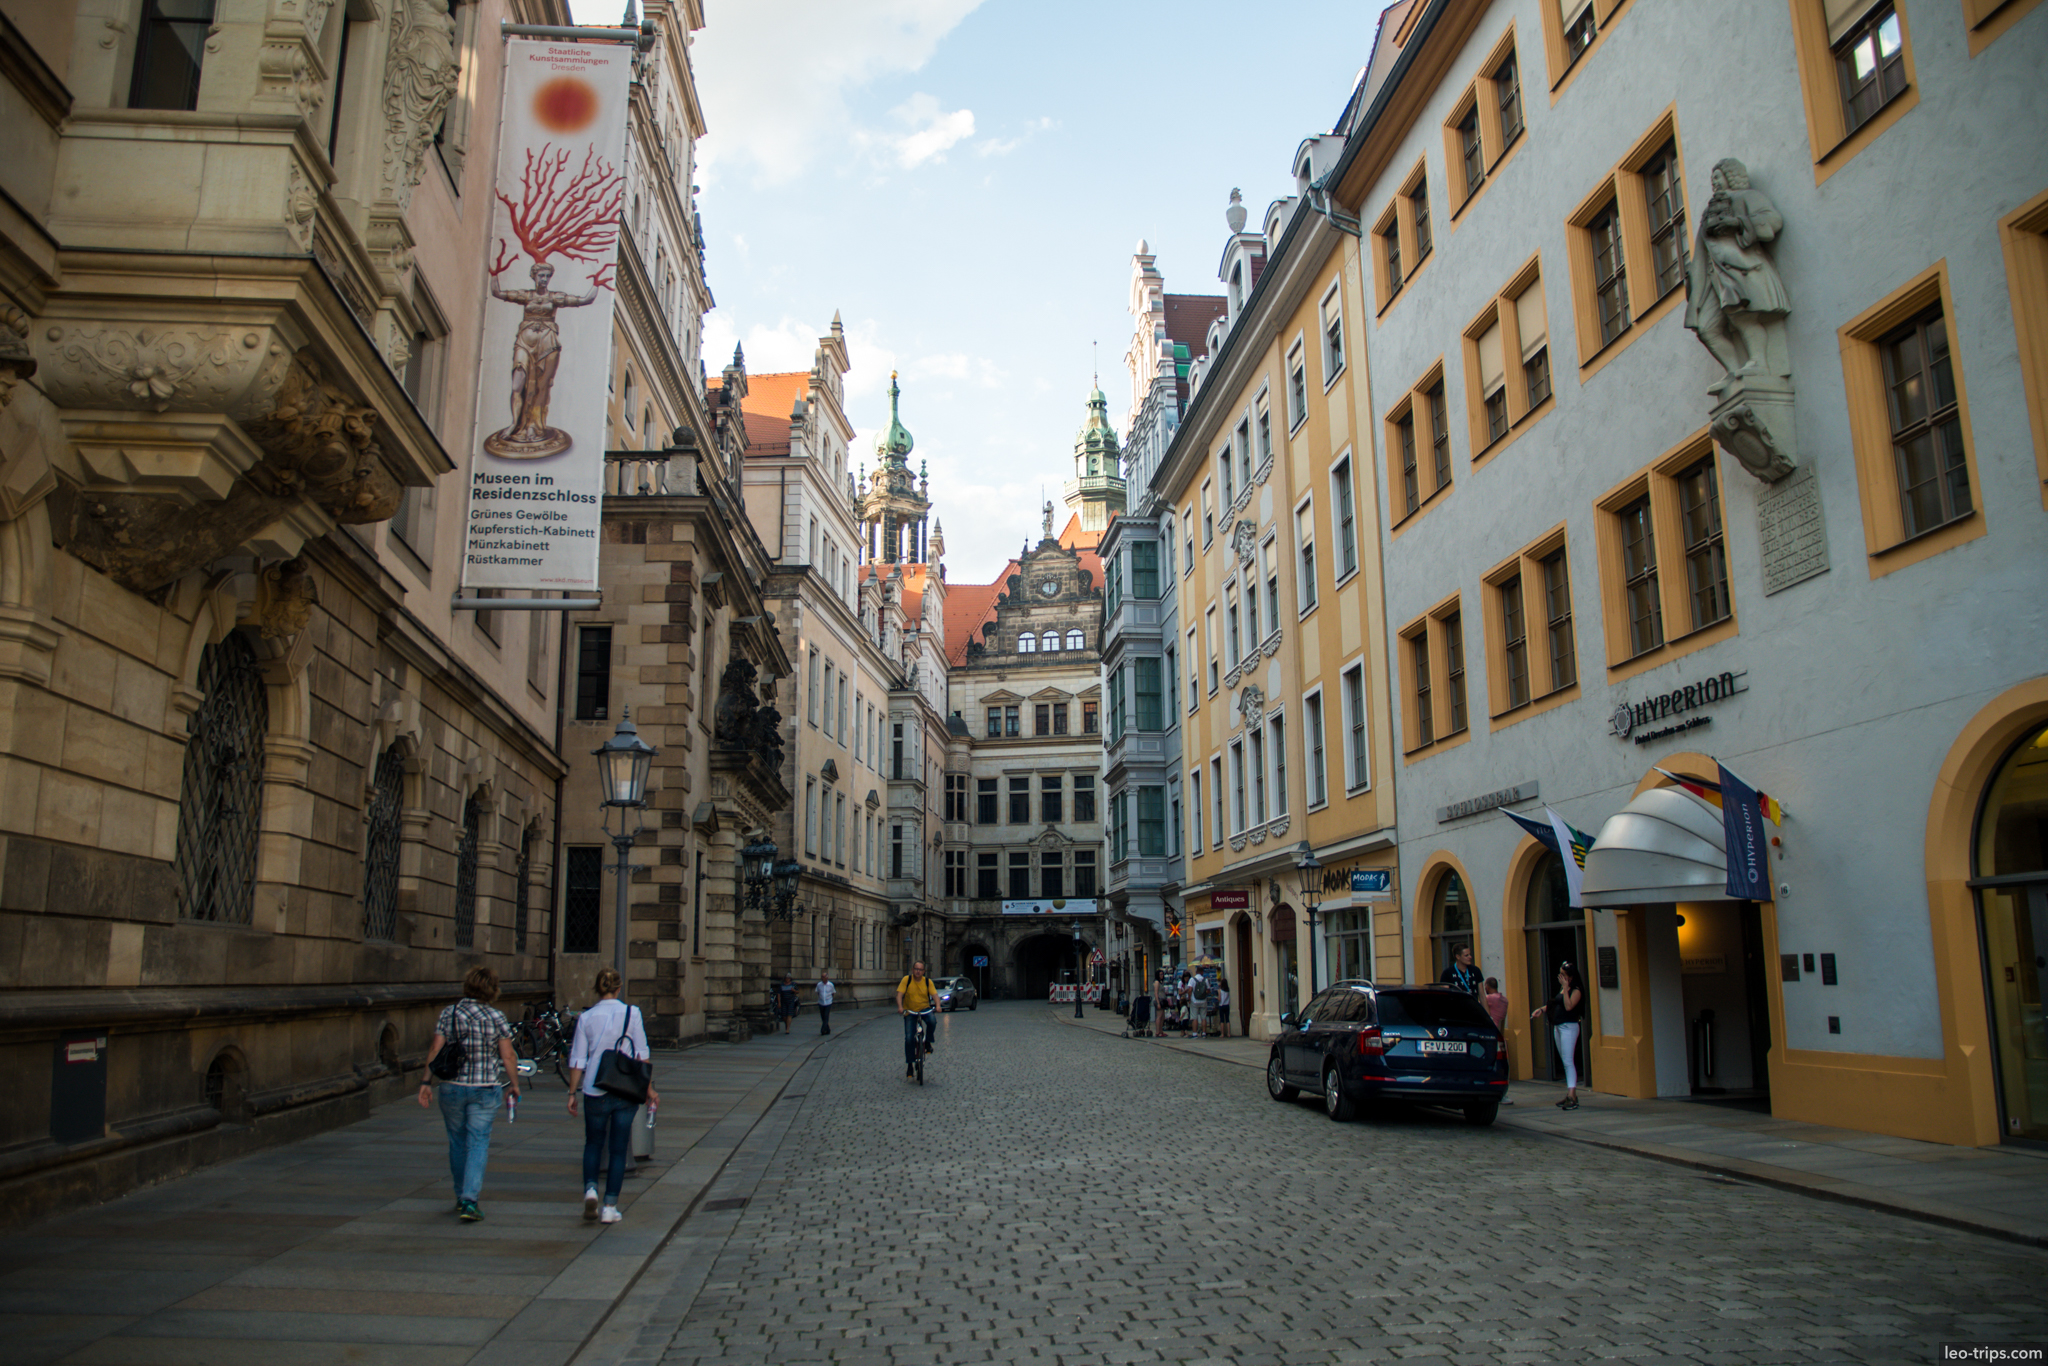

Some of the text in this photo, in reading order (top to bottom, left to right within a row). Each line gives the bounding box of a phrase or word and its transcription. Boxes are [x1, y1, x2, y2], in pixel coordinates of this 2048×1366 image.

[548, 47, 591, 57] Staatliche
[529, 54, 609, 66] Kunstsammlungen
[551, 63, 586, 72] Dresden
[473, 473, 554, 485] Museen im
[472, 488, 597, 504] Residenzschloss
[471, 509, 568, 521] Grünes Gewölbe
[469, 524, 596, 538] Kupferstich-Kabinett
[468, 539, 550, 551] Münzkabinett
[467, 555, 544, 566] Rüstkammer
[1635, 671, 1735, 726] HYPERION
[1741, 803, 1757, 866] HYPERION
[1780, 885, 1788, 895] 16
[1215, 896, 1246, 904] Antiques
[1435, 1042, 1446, 1051] VI
[1448, 1043, 1464, 1052] 200
